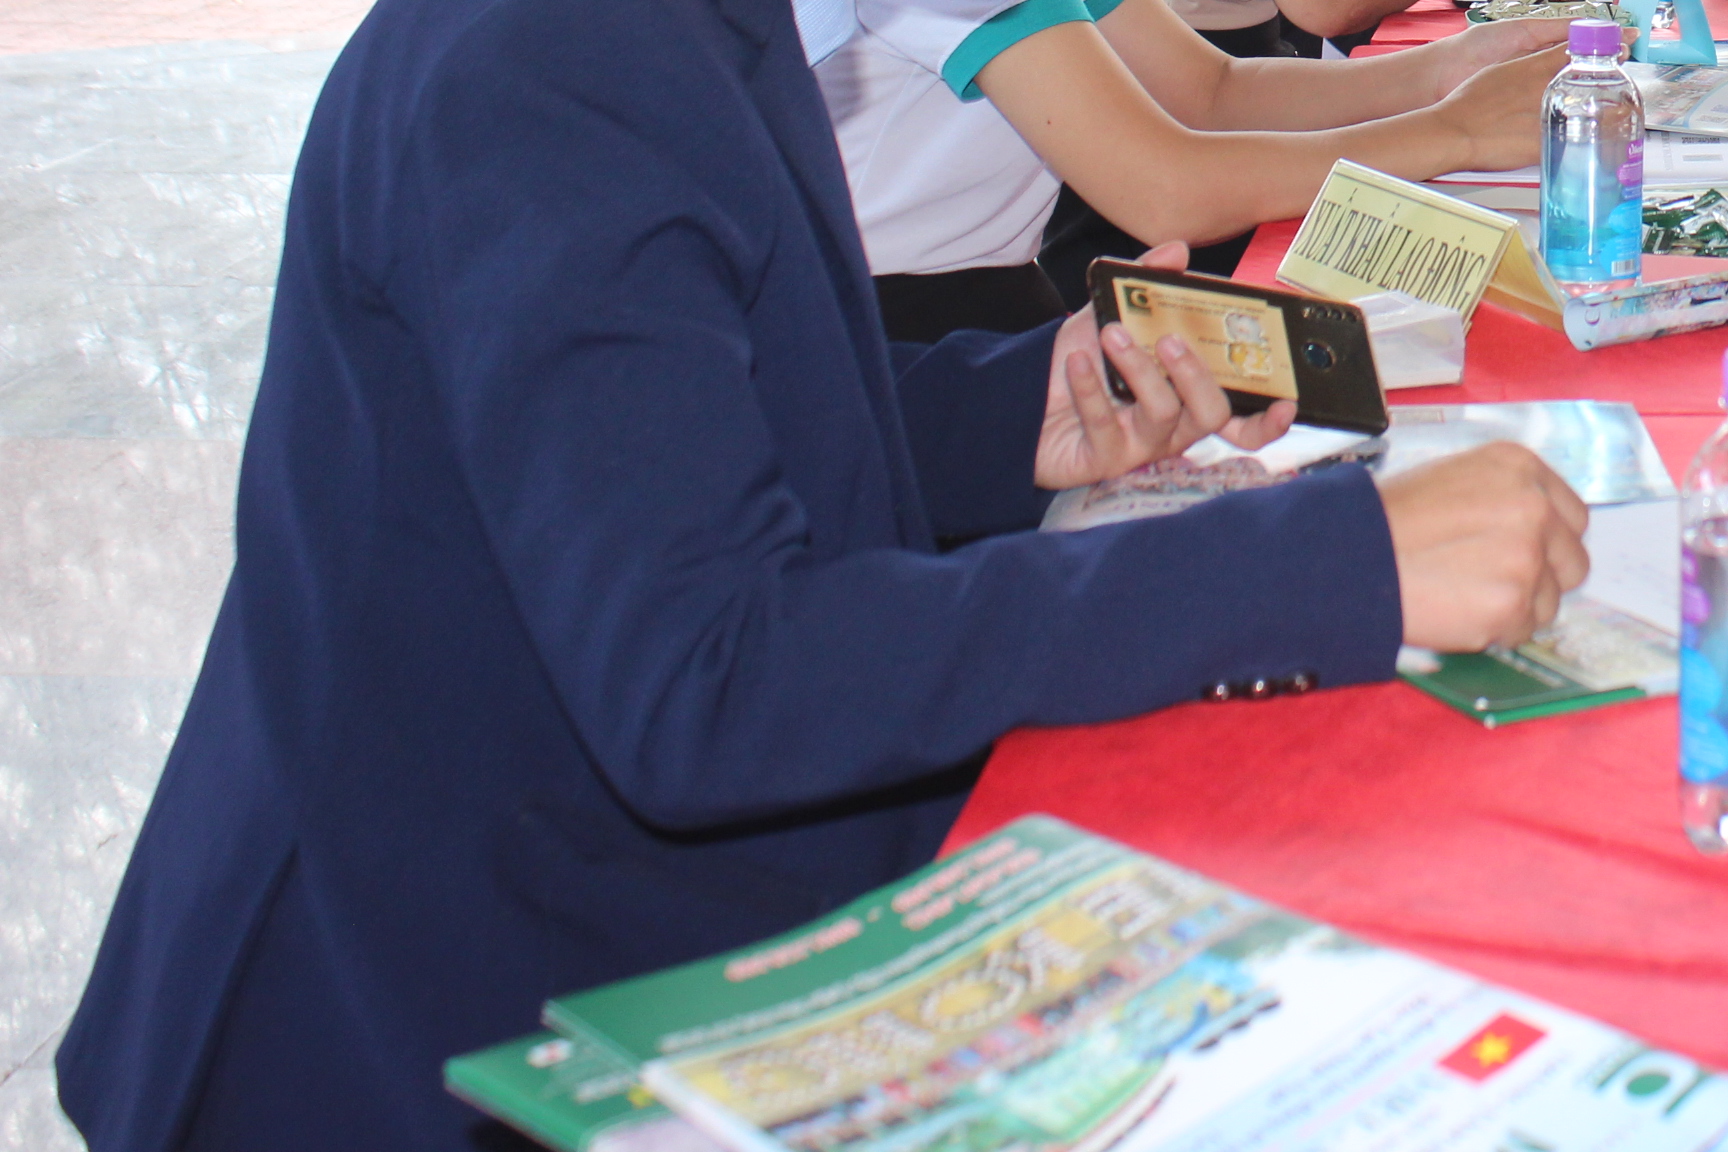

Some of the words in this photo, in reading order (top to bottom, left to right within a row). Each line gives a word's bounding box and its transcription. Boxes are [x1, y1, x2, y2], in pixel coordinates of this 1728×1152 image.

[1295, 188, 1358, 266] XUẤT
[1334, 202, 1404, 284] KHẨU
[1377, 229, 1435, 295] LAO
